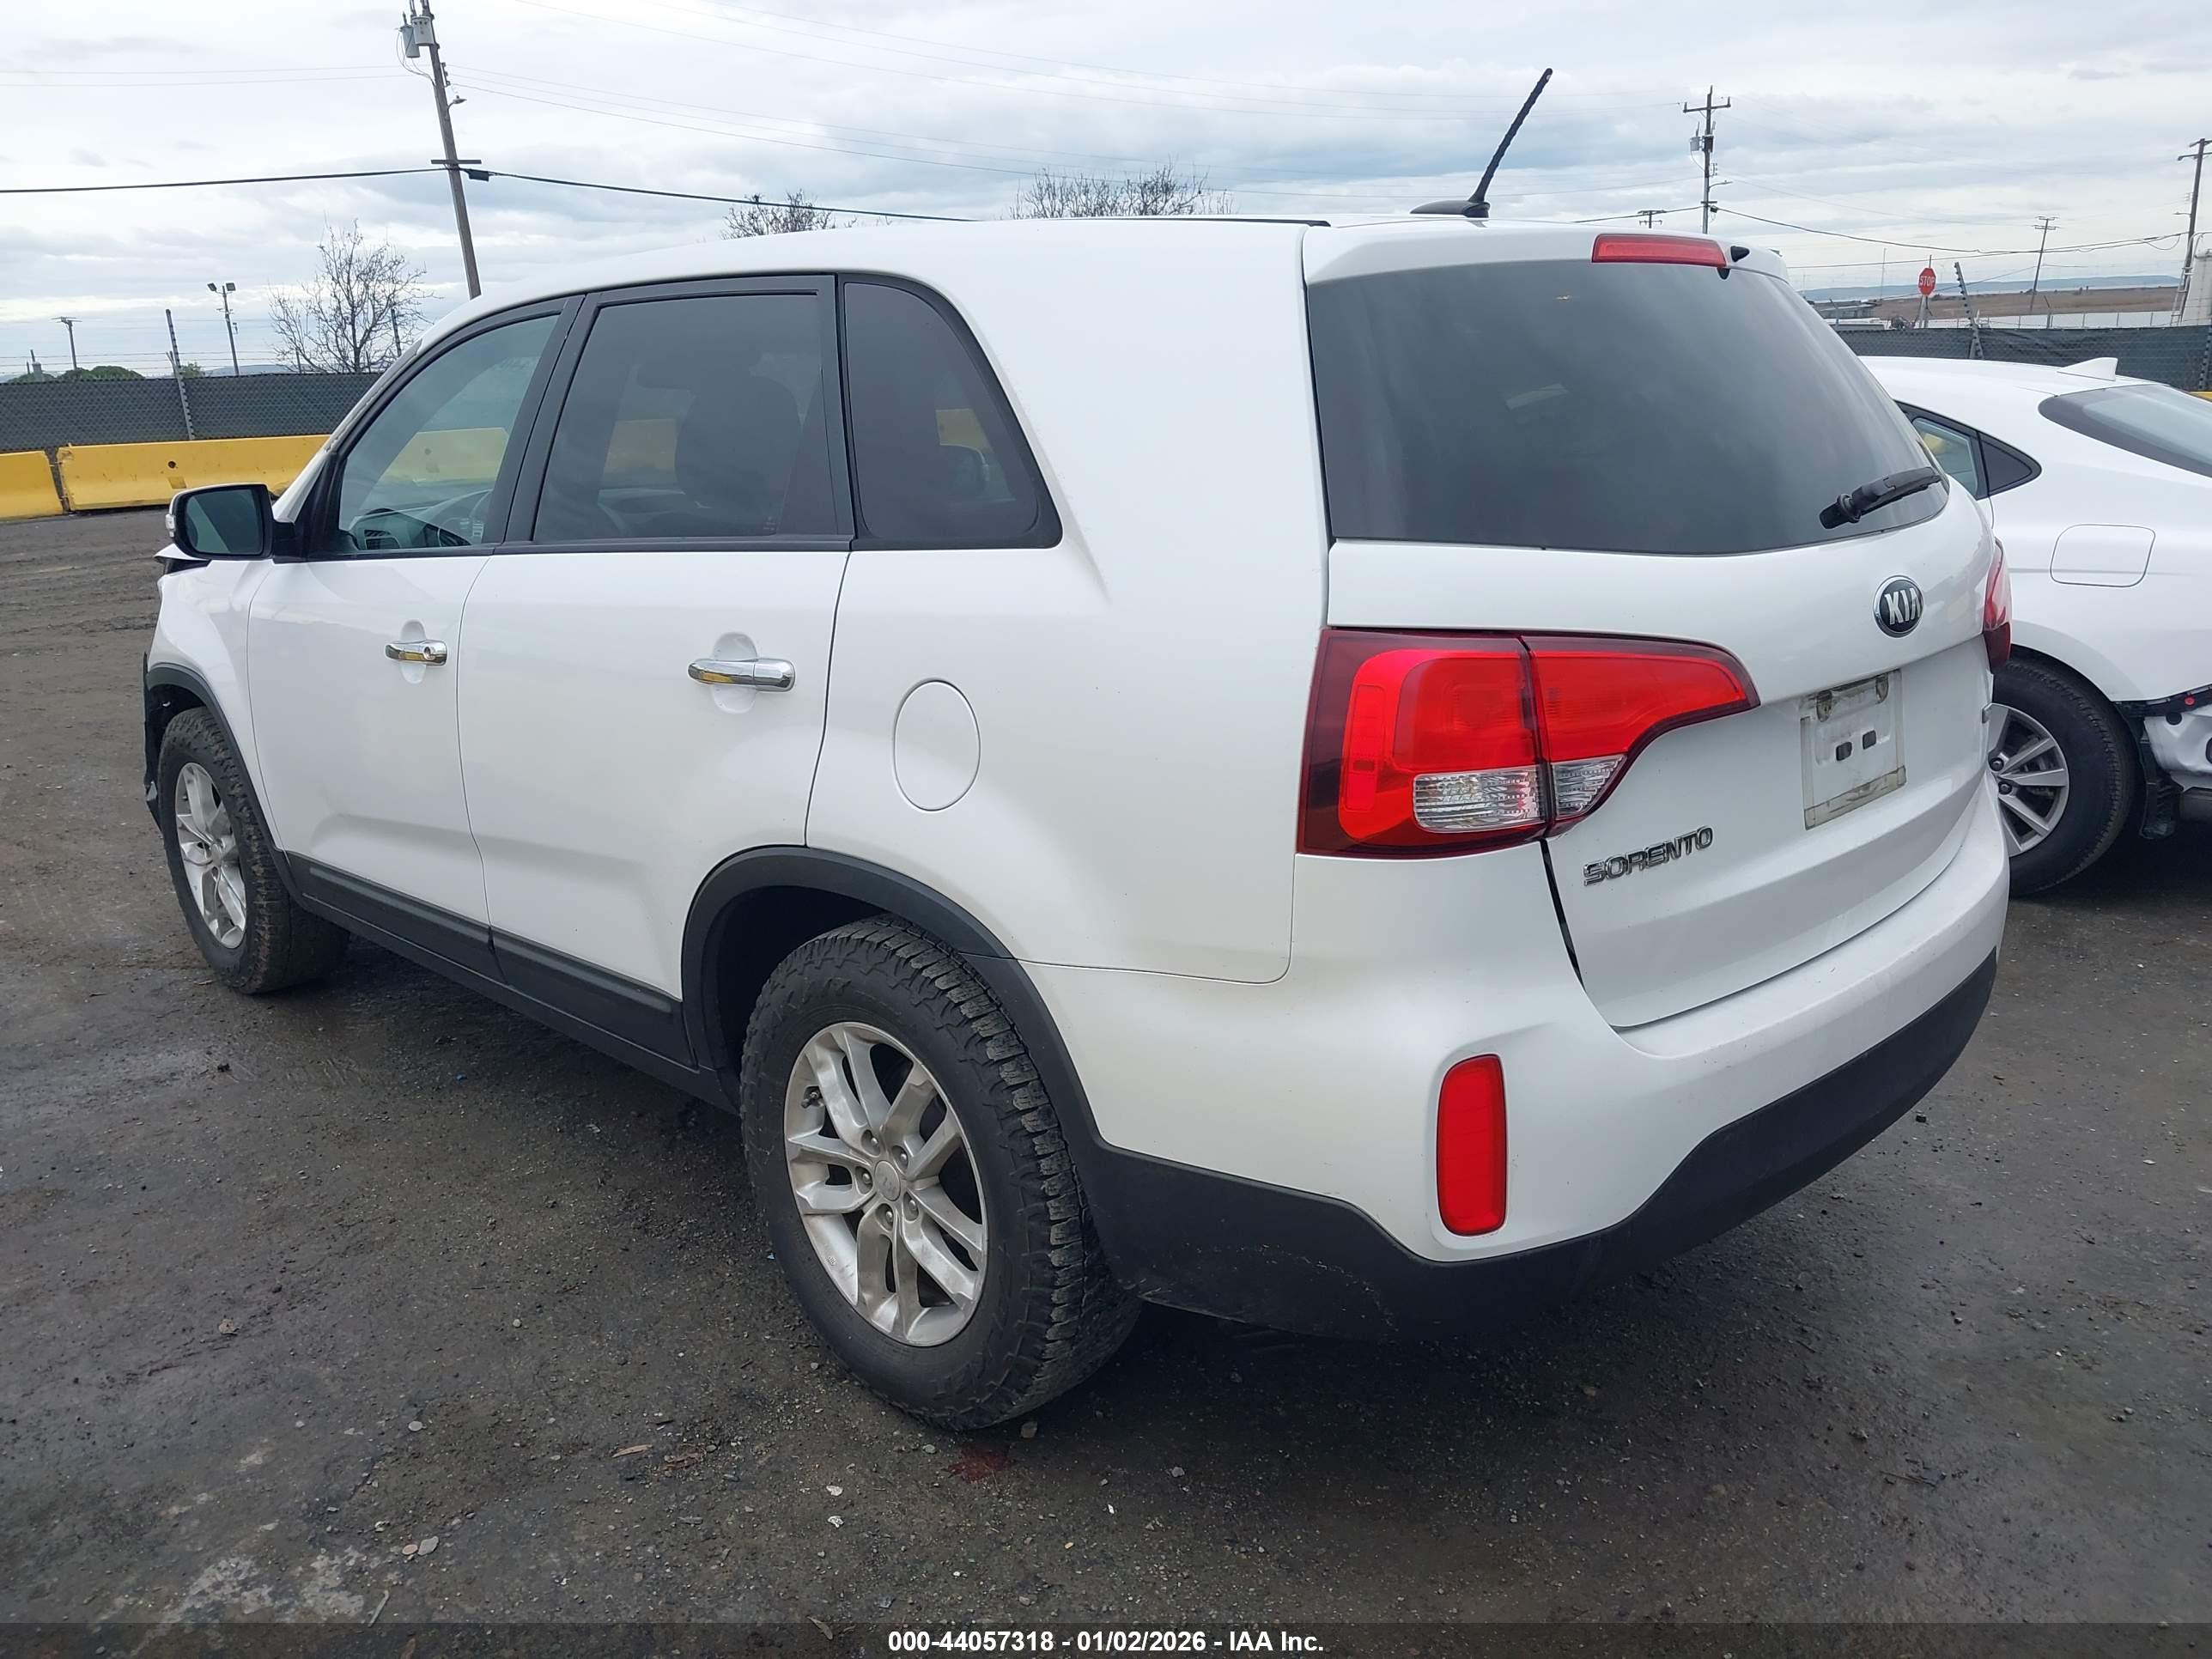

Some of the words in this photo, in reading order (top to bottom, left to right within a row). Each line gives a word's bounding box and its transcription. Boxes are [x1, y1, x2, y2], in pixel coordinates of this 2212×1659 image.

[1919, 276, 1936, 287] STOP
[1884, 587, 1921, 625] KIA
[1583, 825, 1713, 887] SORENTO
